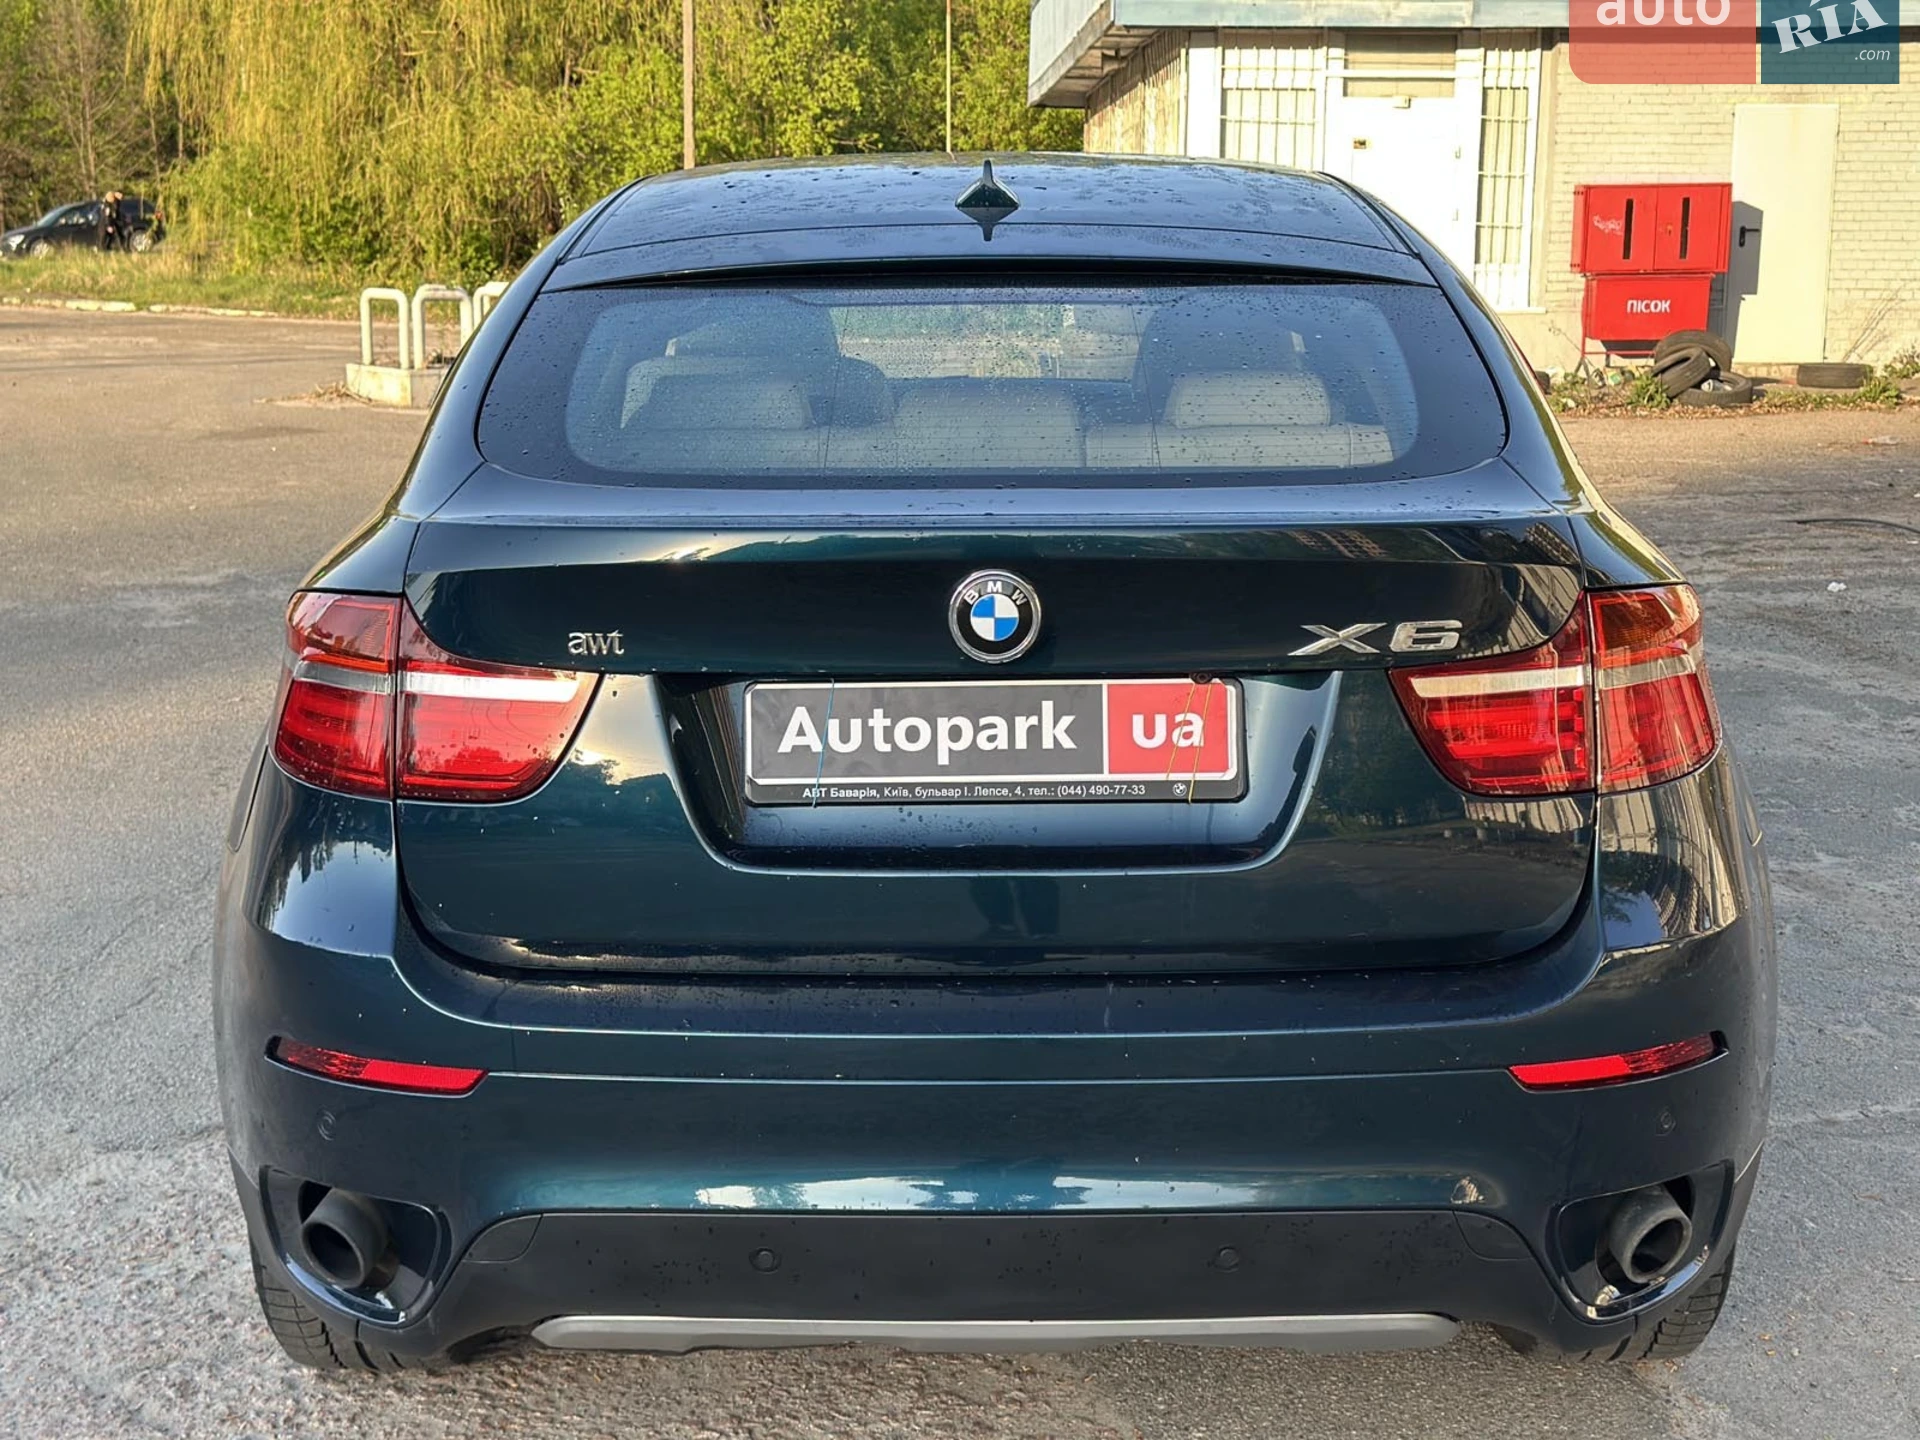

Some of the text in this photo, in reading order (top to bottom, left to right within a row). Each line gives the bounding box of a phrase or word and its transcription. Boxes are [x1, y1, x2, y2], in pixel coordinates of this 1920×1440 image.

[1626, 299, 1671, 314] ПІСОК
[963, 580, 1028, 606] BMW
[568, 629, 625, 656] awt
[1287, 619, 1463, 656] X6
[777, 700, 1205, 766] Autopark ua
[830, 787, 880, 800] Баварія,
[883, 786, 912, 798] Київ,
[915, 786, 961, 800] бульвар
[973, 785, 1012, 798] Лепсе,
[1014, 785, 1026, 797] 4,
[1028, 785, 1055, 796] тел.:
[1057, 784, 1087, 797] (044)
[1088, 784, 1146, 796] 490-77-33
